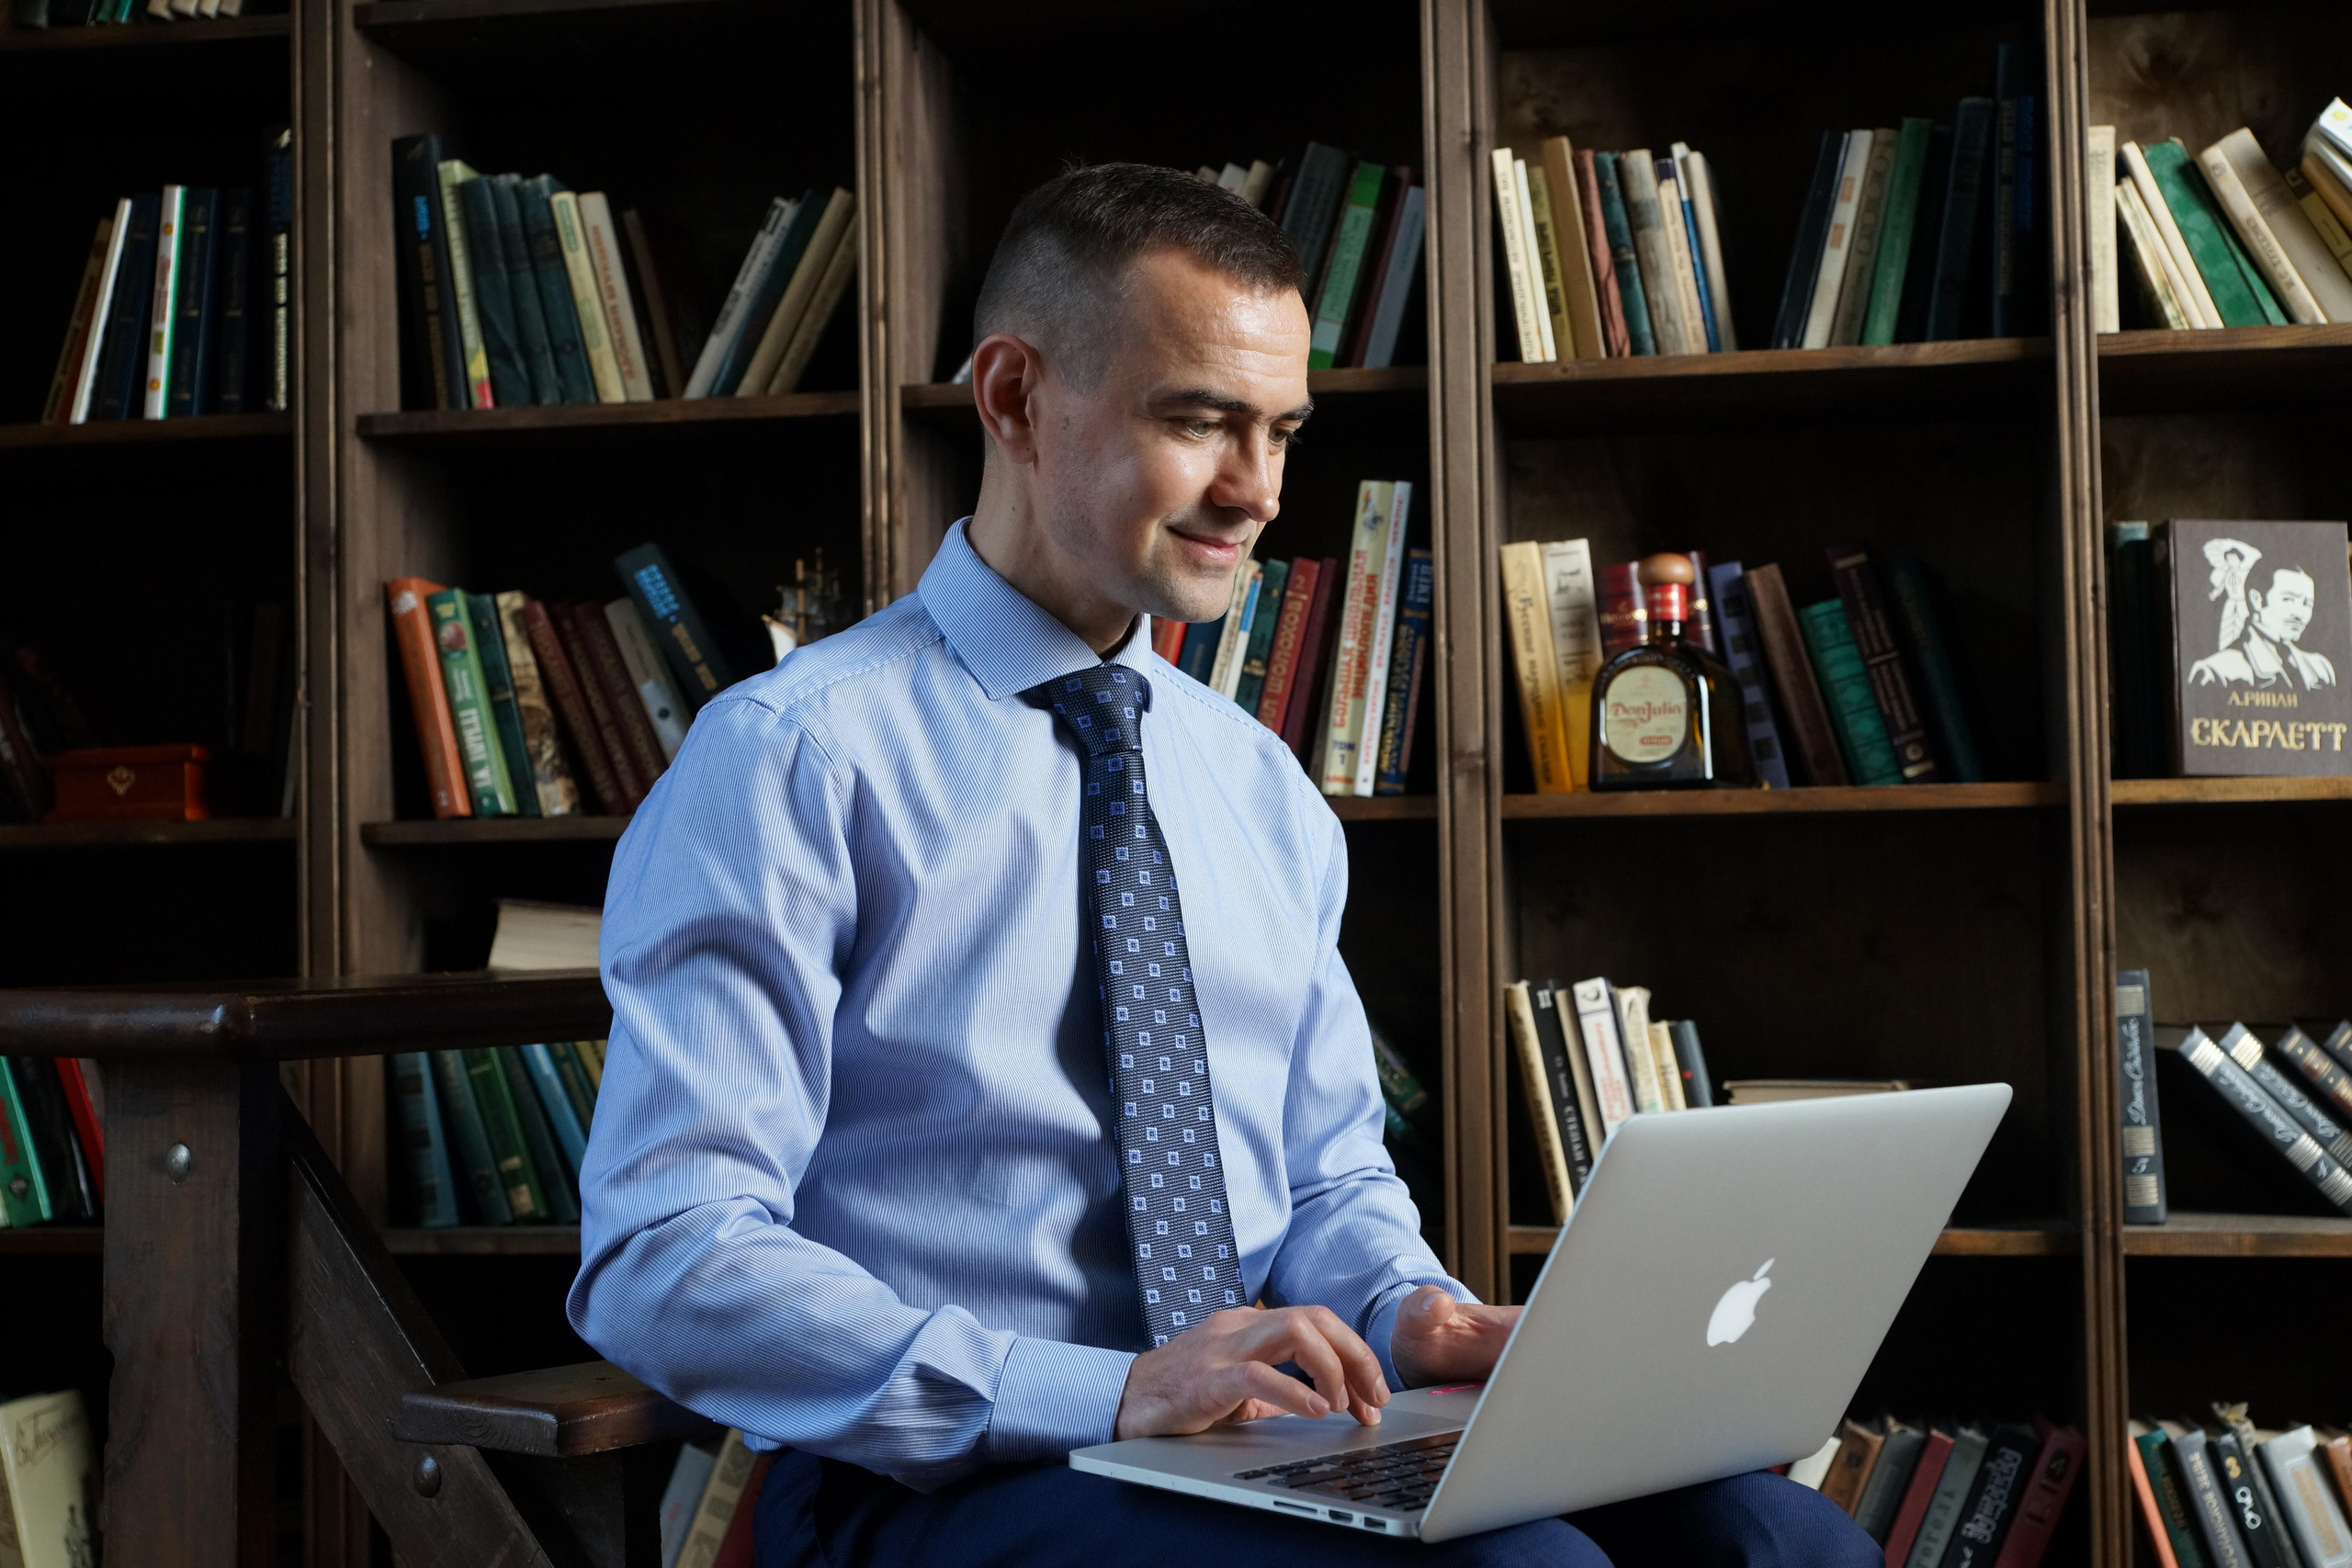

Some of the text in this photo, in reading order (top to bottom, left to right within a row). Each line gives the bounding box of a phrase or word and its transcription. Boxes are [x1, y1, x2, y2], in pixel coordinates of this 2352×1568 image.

[1351, 573, 1381, 698] ЭНЦИКЛОПЕДИЯ
[1332, 646, 1359, 728] БОЛЬШАЯ
[1332, 739, 1355, 752] ТОМ
[2191, 716, 2346, 751] СКАРЛЕТТ
[1563, 1105, 1584, 1161] СТЕПАН
